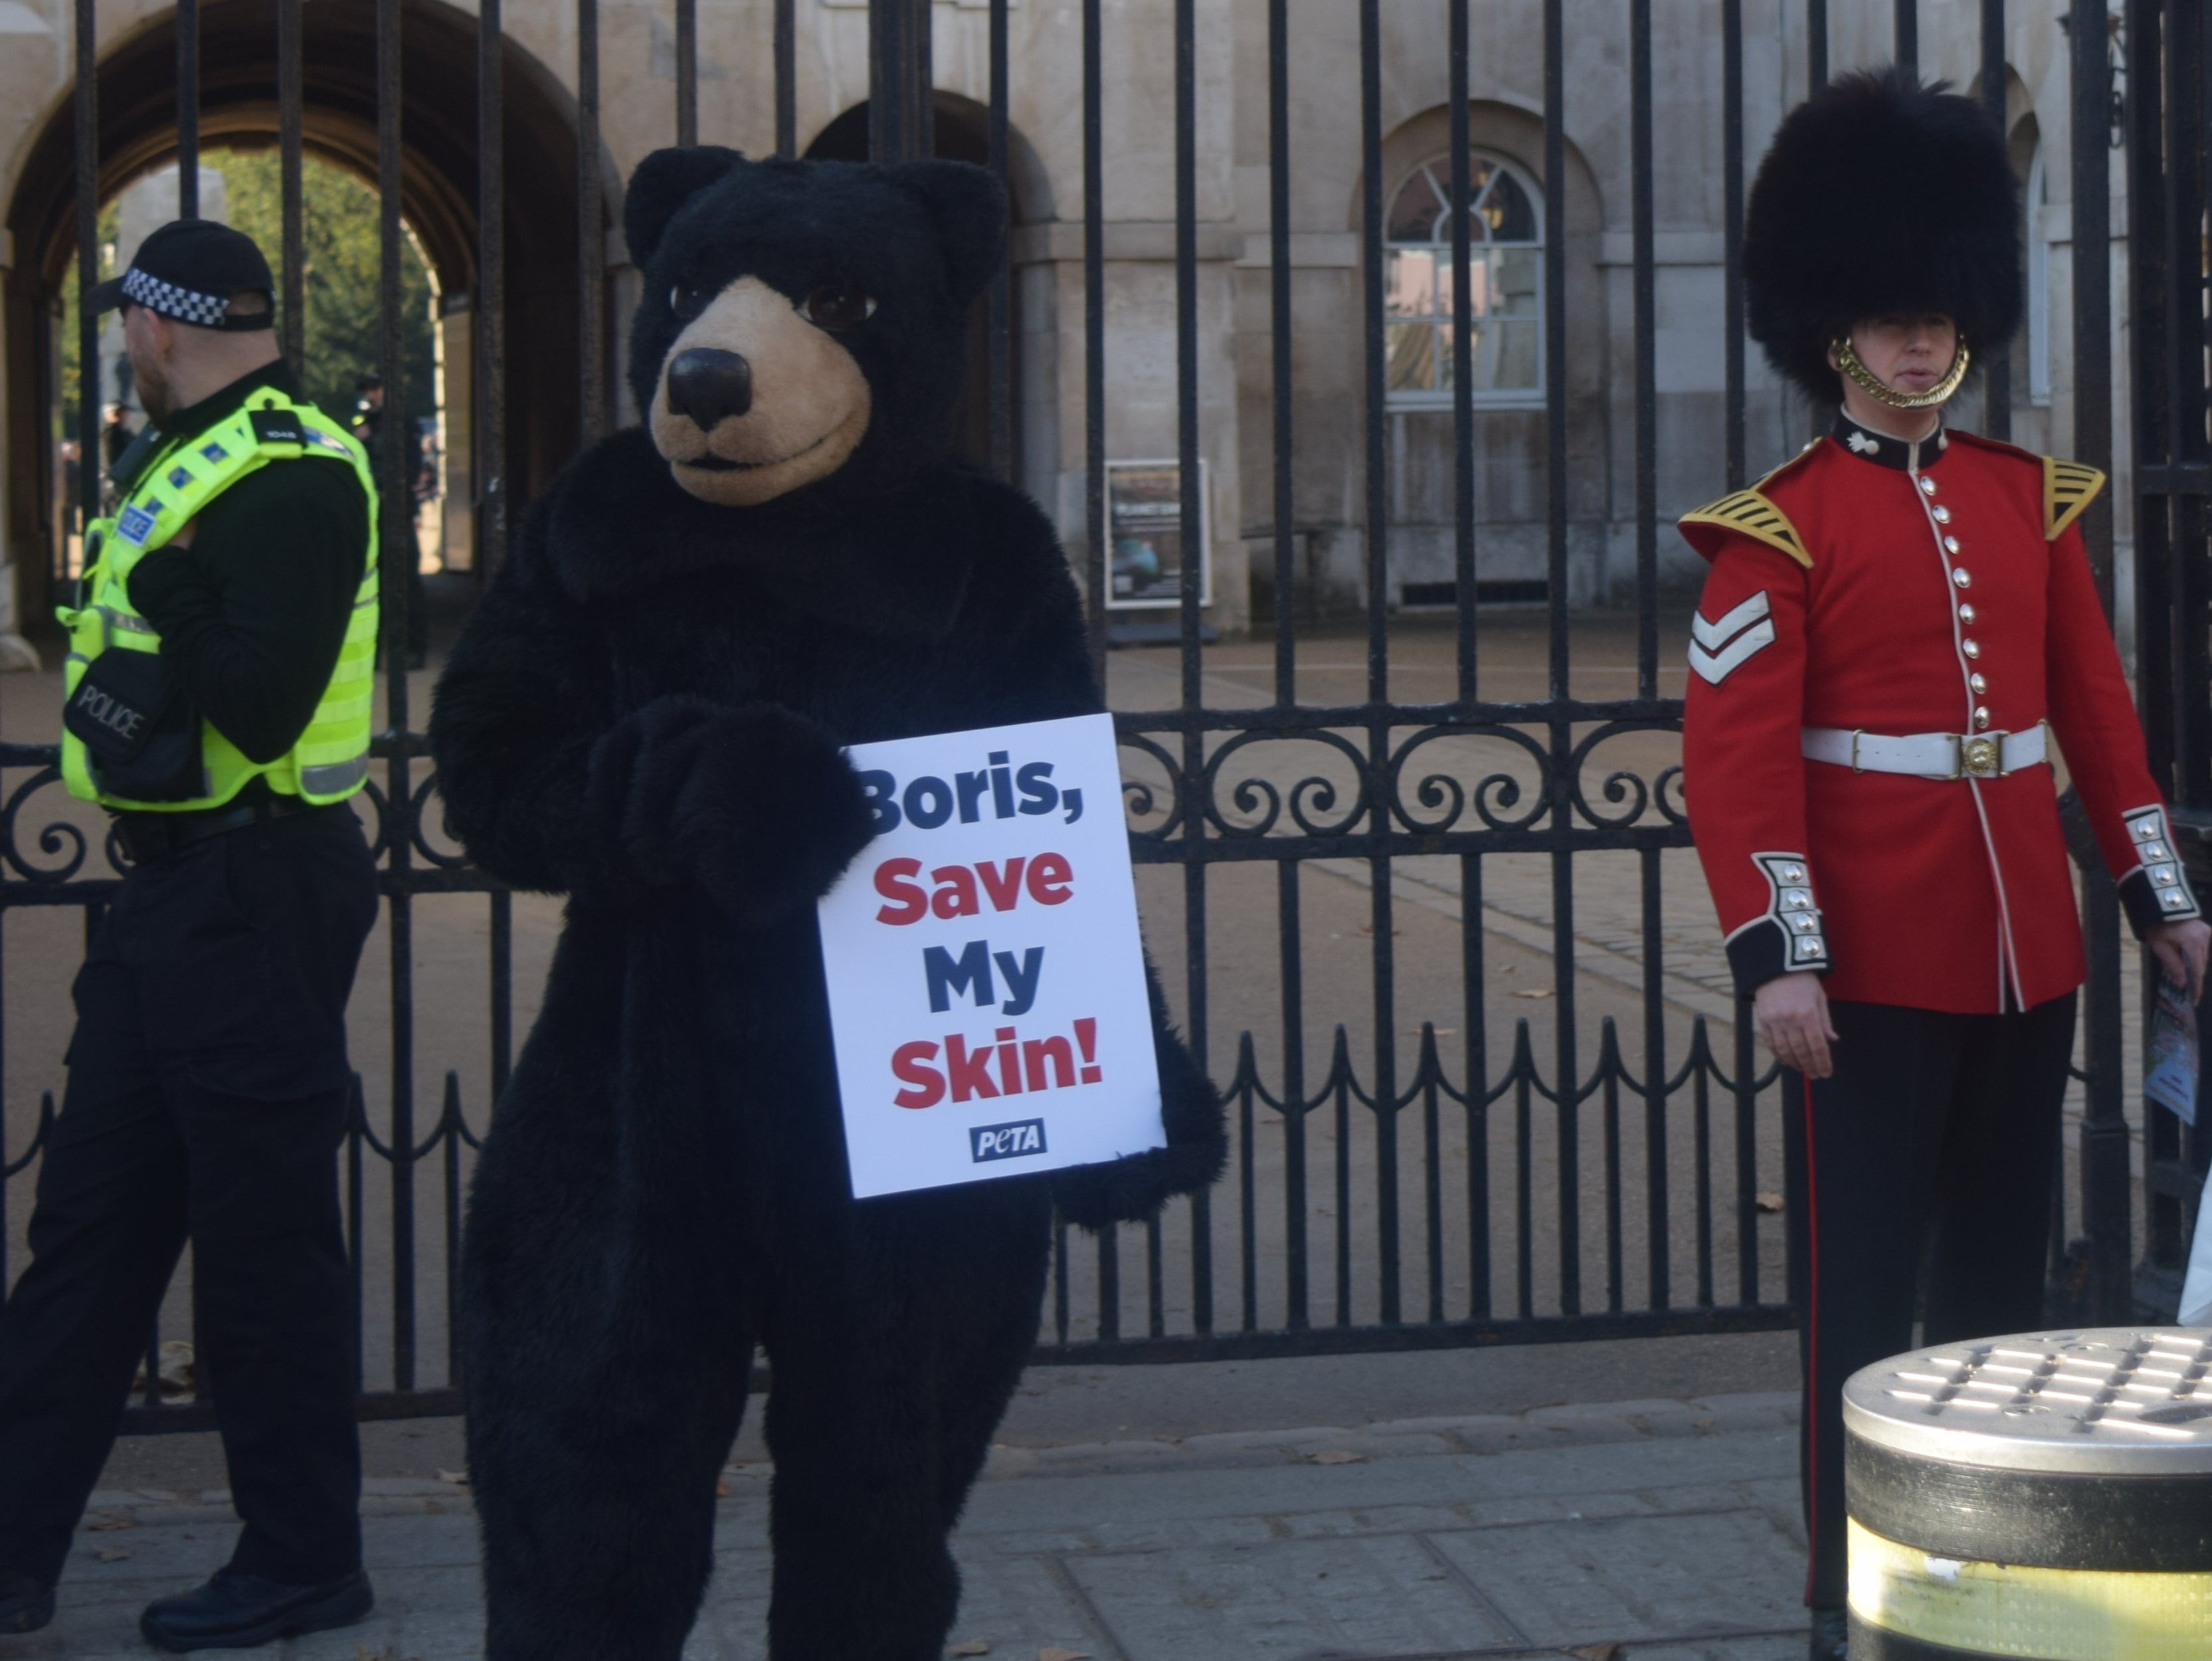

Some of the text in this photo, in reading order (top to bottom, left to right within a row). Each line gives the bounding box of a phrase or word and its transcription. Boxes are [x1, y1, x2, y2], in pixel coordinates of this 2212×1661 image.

[77, 685, 146, 739] POLICE
[859, 750, 1083, 835] Boris,
[873, 852, 1074, 926] Save
[923, 939, 1045, 1017] My
[891, 1017, 1103, 1110] Skin!
